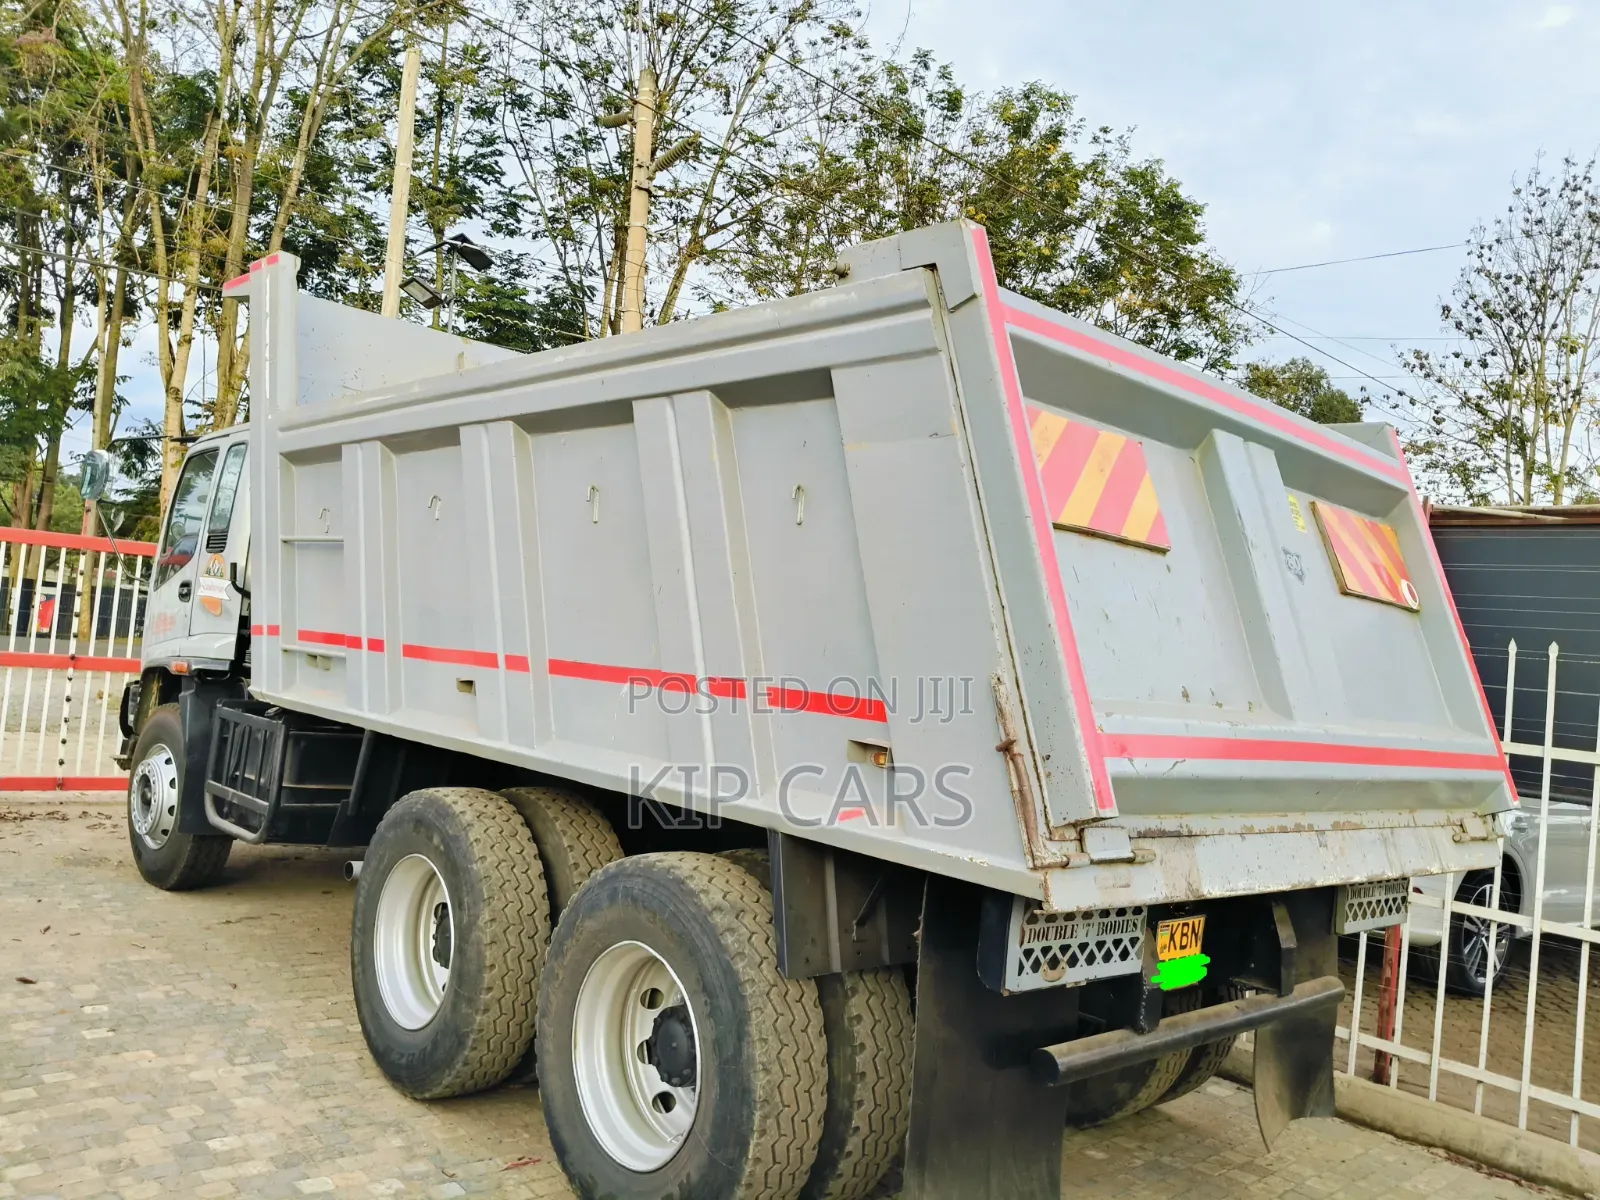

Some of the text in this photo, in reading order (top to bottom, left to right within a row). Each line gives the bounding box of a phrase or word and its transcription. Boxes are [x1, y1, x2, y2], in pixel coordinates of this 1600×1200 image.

[1027, 923, 1079, 944] DOUBLE
[1096, 917, 1139, 937] BODIES
[1168, 918, 1202, 953] KBN
